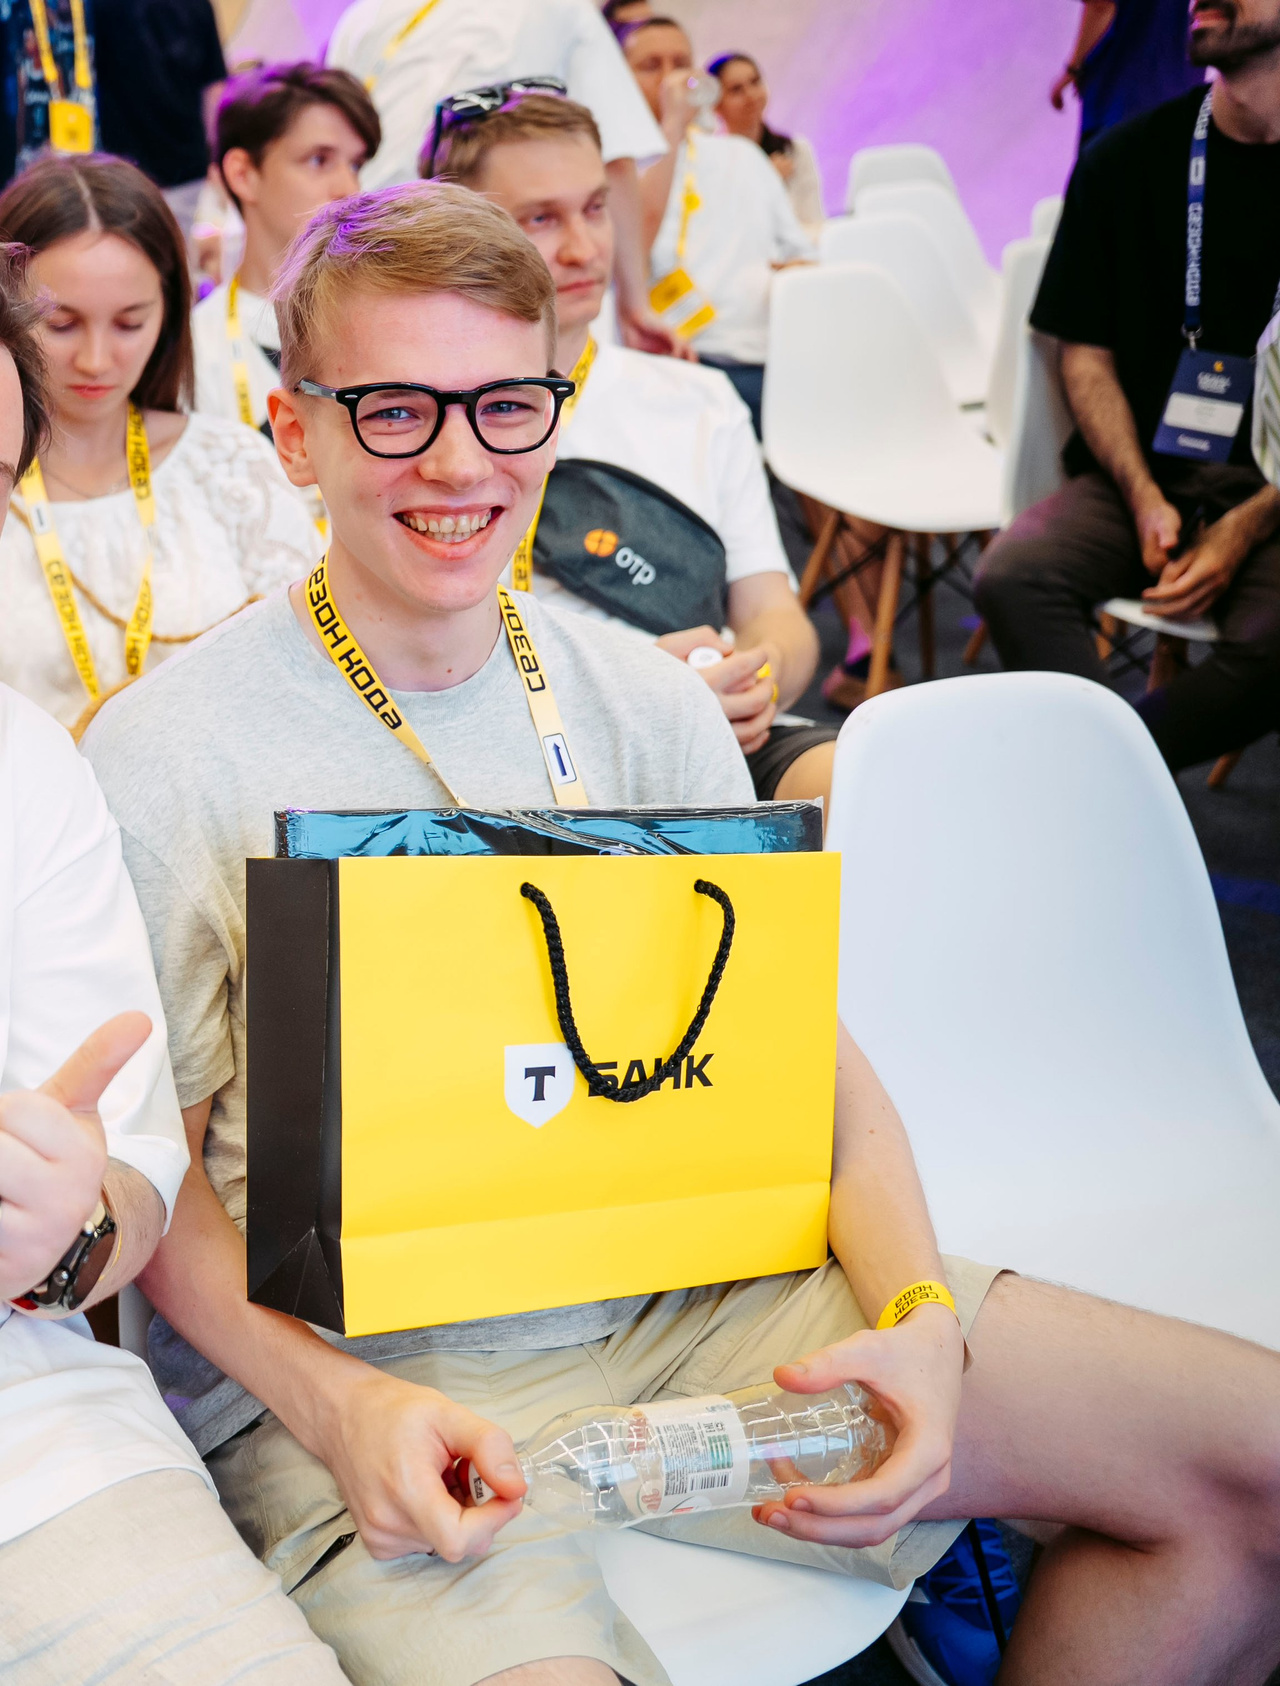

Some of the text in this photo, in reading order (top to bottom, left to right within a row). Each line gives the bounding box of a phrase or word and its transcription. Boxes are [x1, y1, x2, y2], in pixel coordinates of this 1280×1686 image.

[499, 591, 546, 692] сезон
[338, 647, 403, 730] кода
[588, 1053, 715, 1097] БАНК
[893, 1291, 939, 1319] сезон
[894, 1284, 933, 1309] кода
